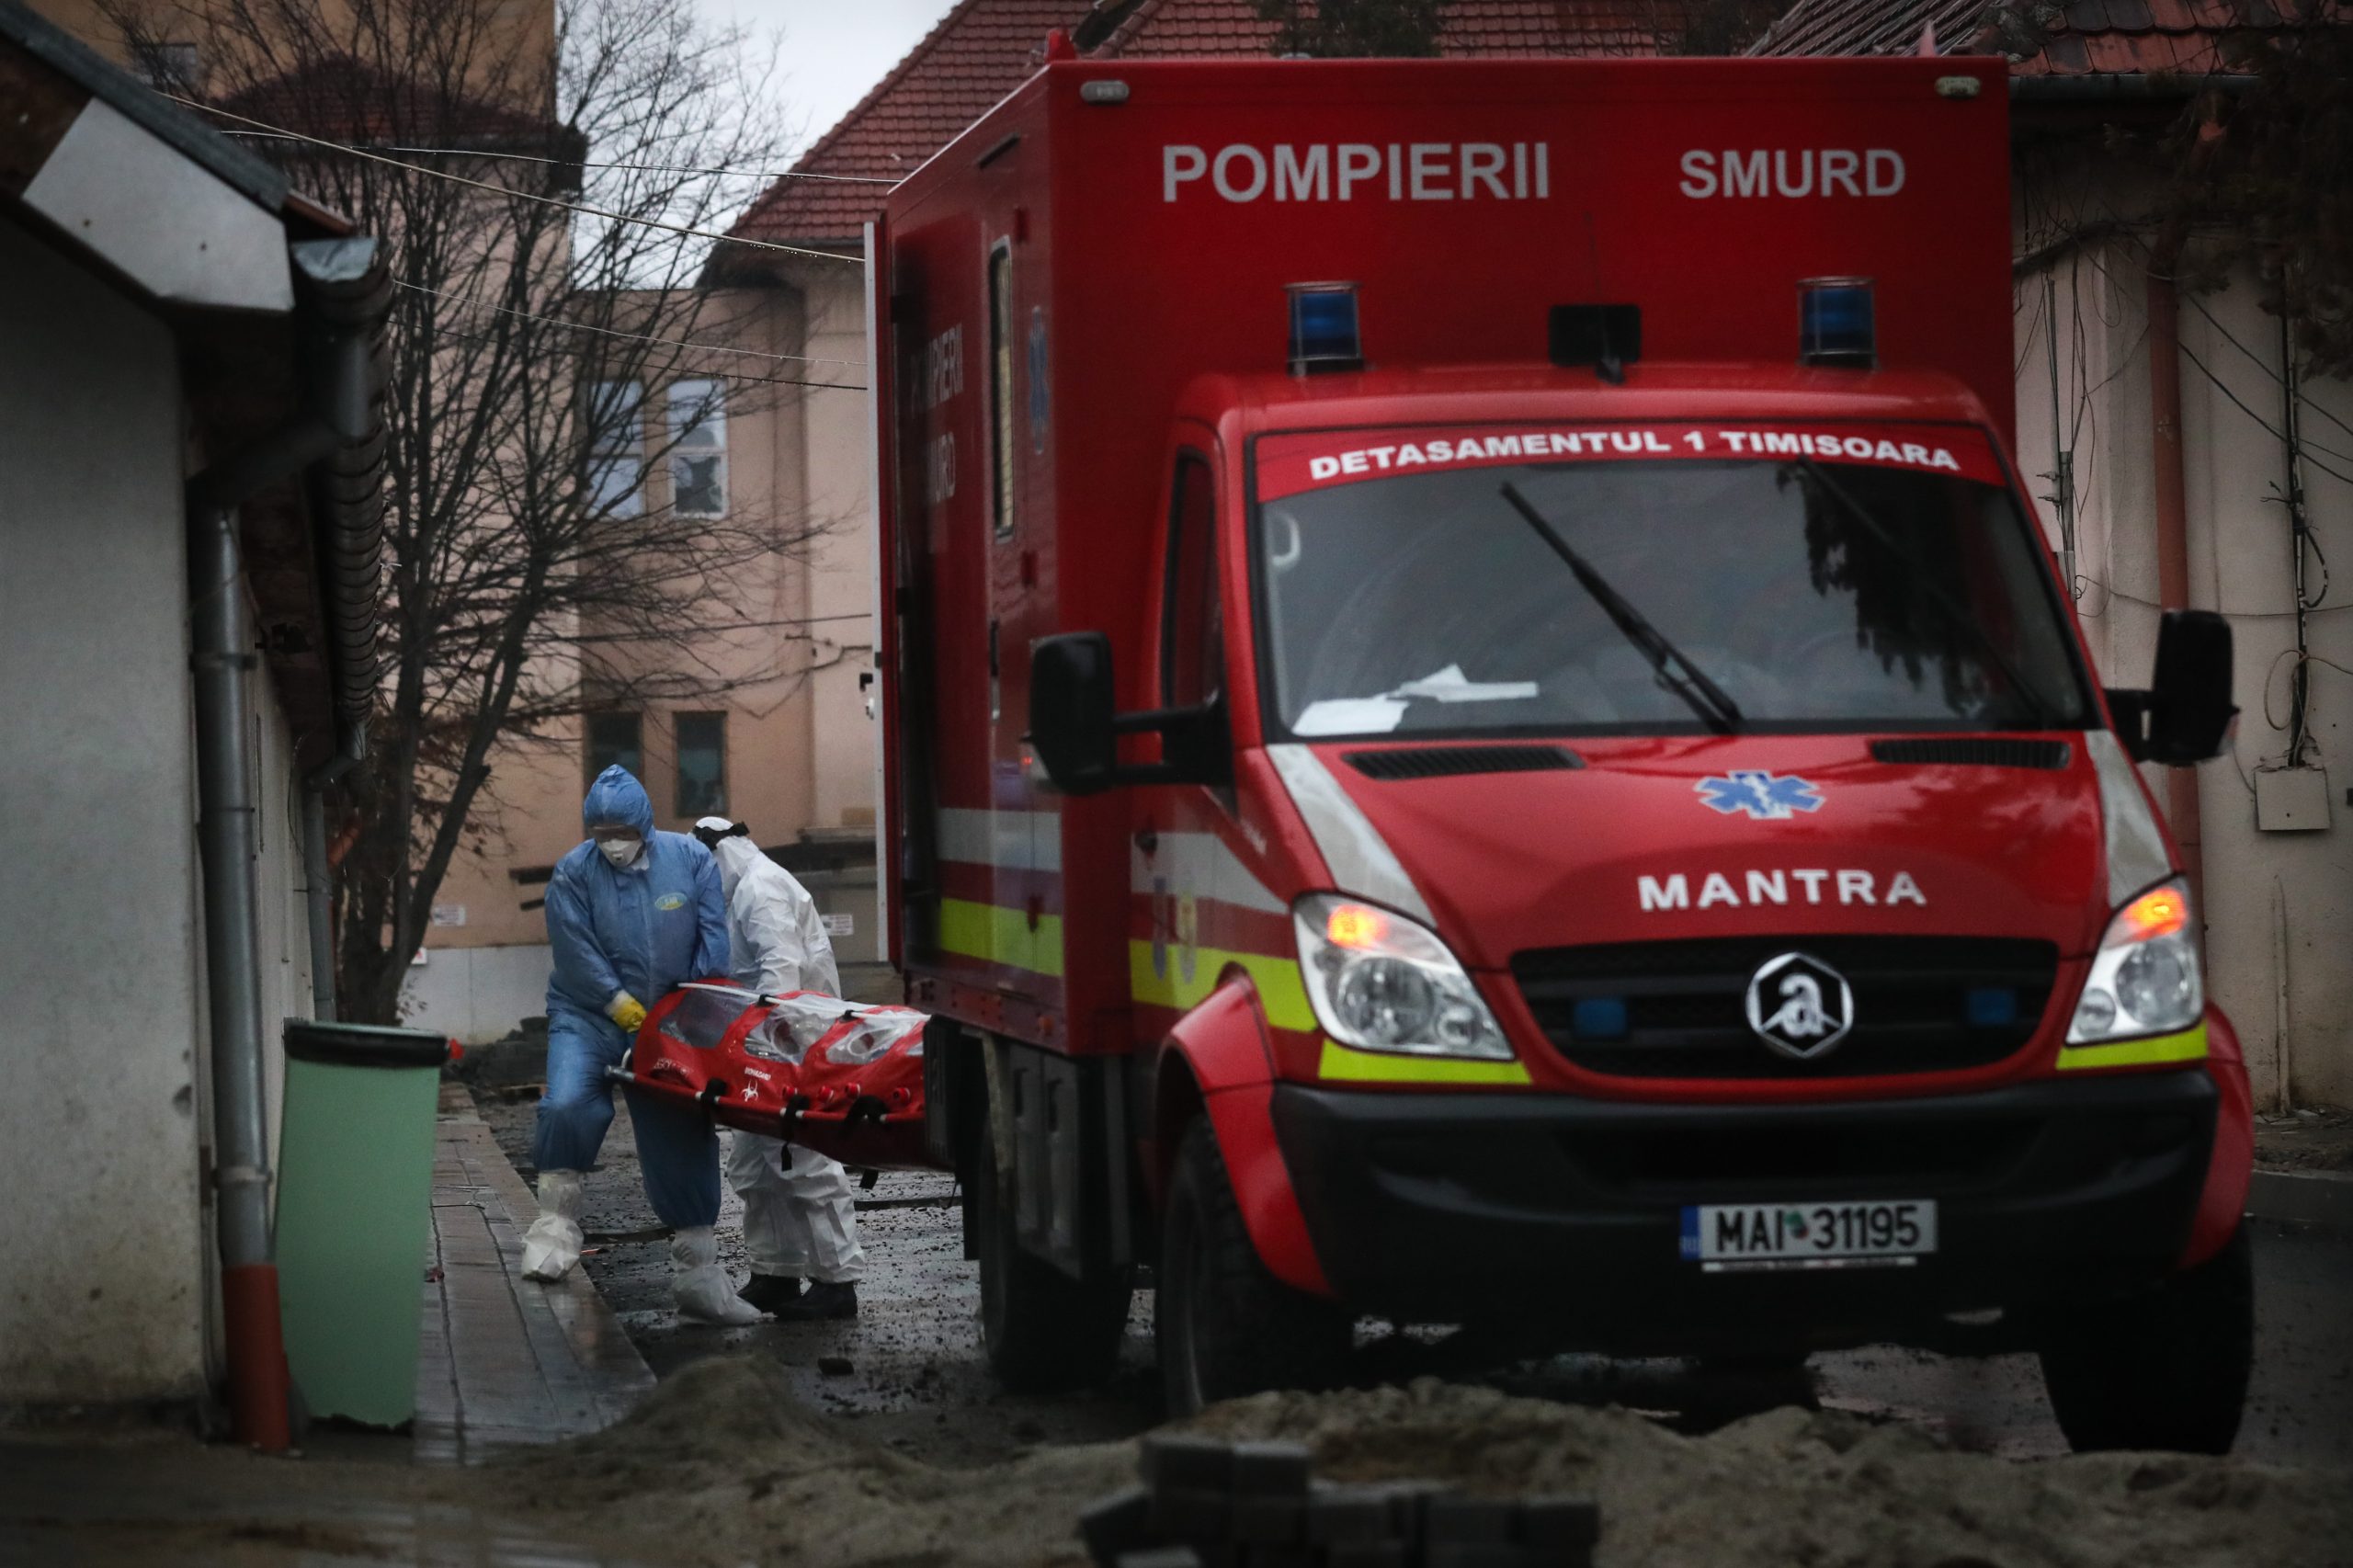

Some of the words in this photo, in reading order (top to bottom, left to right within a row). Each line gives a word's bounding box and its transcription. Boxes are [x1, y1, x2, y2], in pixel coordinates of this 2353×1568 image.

[1163, 142, 1550, 202] POMPIERII
[1679, 149, 1906, 199] SMURD
[917, 323, 963, 412] PIERII
[1309, 431, 1672, 481] DETASAMENTUL
[1683, 431, 1705, 451] 1
[1719, 431, 1961, 472] TIMISOARA
[1637, 869, 1927, 911] MANTRA
[1716, 1210, 1785, 1254] MAI
[1812, 1204, 1920, 1250] 31195
